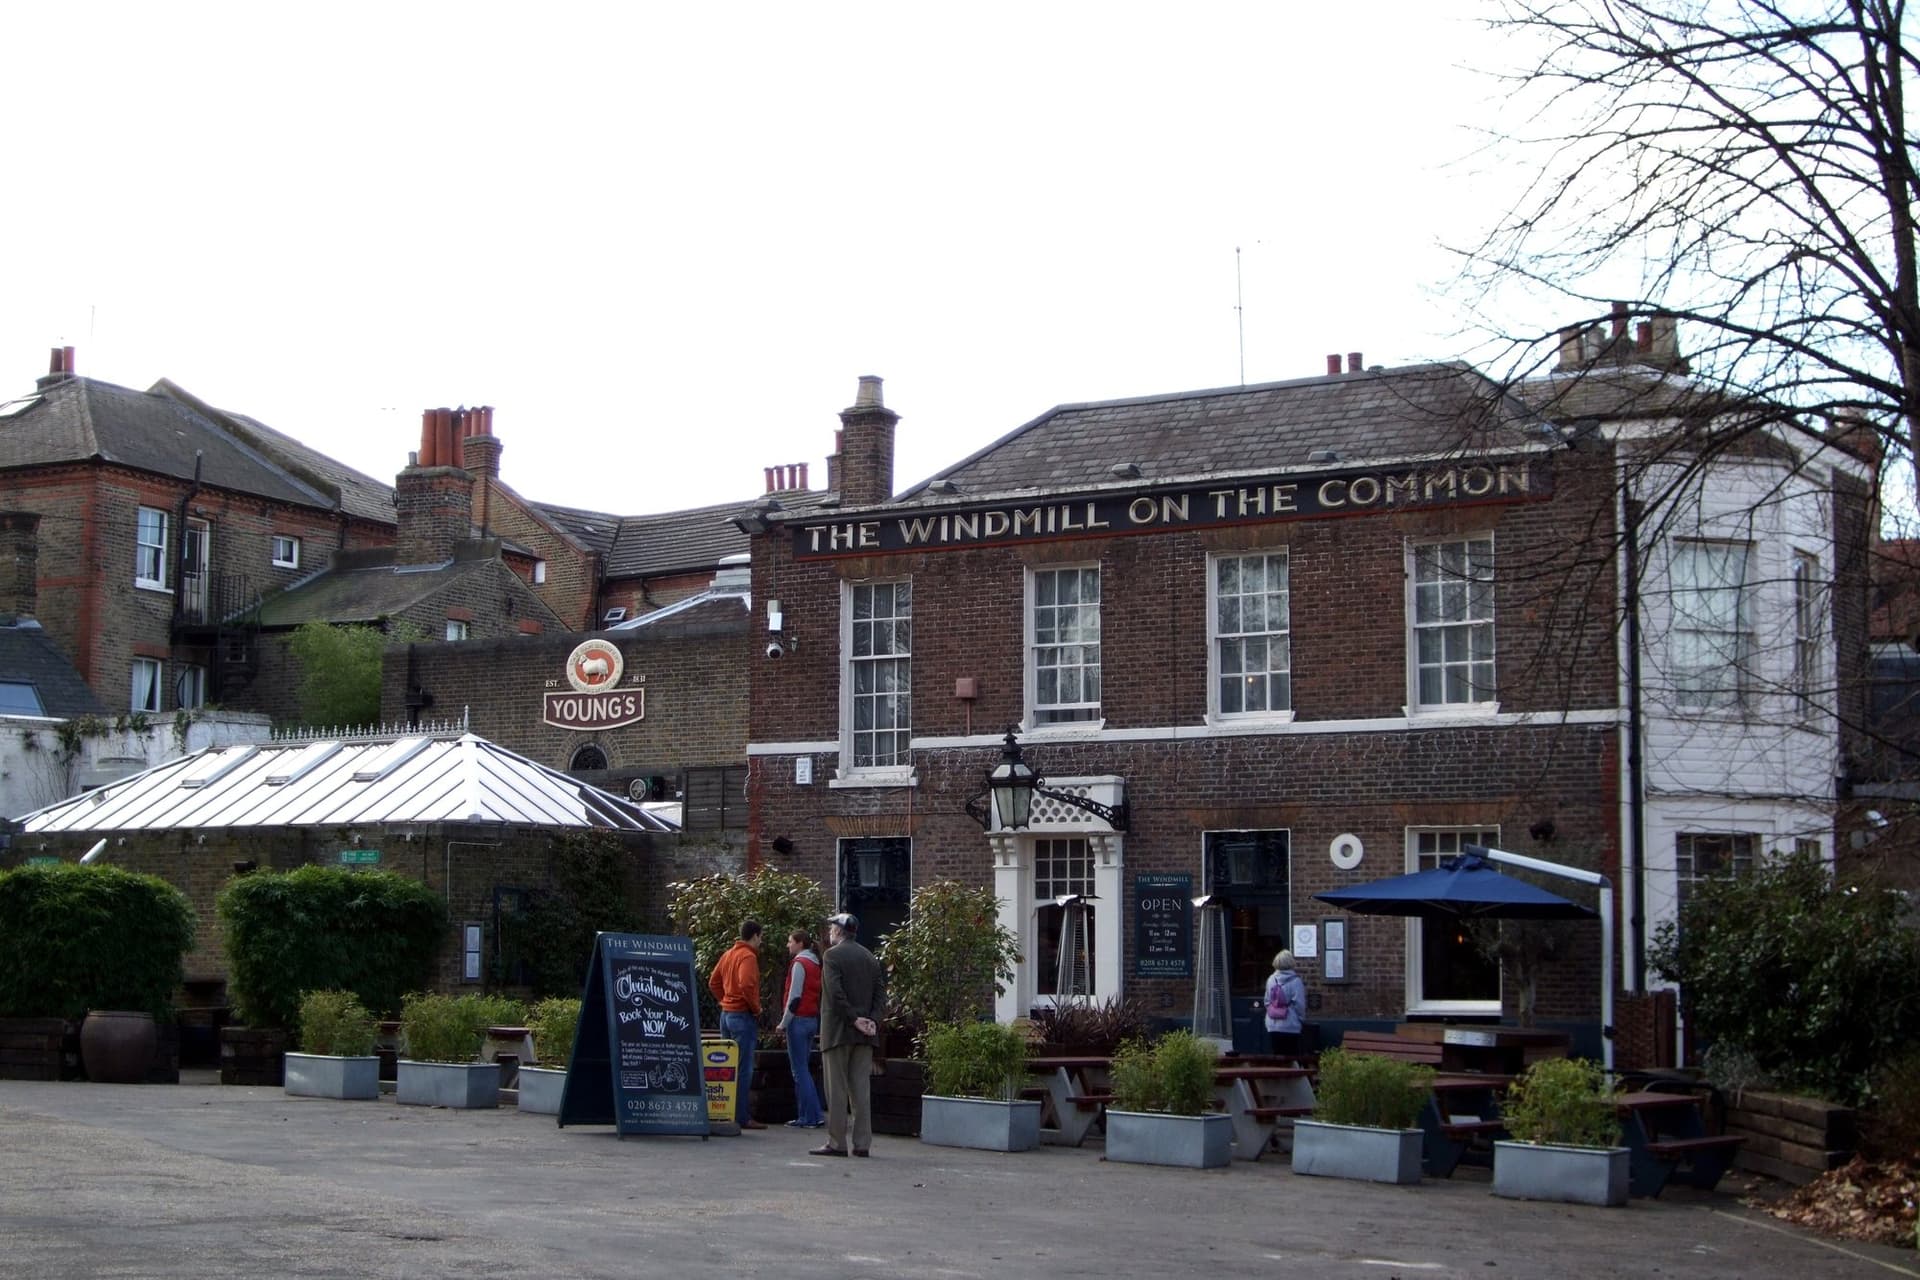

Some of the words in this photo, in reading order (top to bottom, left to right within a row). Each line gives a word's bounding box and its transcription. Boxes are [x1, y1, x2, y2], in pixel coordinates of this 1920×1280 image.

[805, 521, 881, 552] THE
[898, 501, 1110, 545] WINDMILL
[1128, 494, 1190, 524] ON
[1209, 484, 1299, 518] THE
[1318, 464, 1530, 508] COMMON
[552, 694, 636, 722] YOUNG'S
[1138, 875, 1151, 883] THE
[1152, 875, 1189, 883] WINDMILL
[1141, 898, 1183, 911] OPEN
[606, 938, 628, 948] THE
[631, 939, 688, 951] WINDMILL
[614, 973, 680, 1003] Christmas
[619, 1008, 642, 1024] Book
[643, 1008, 664, 1020] Your
[666, 1010, 689, 1031] Party
[642, 1020, 666, 1033] NOW
[627, 1100, 645, 1110] 020
[648, 1101, 672, 1111] 8673
[674, 1101, 698, 1112] 4578
